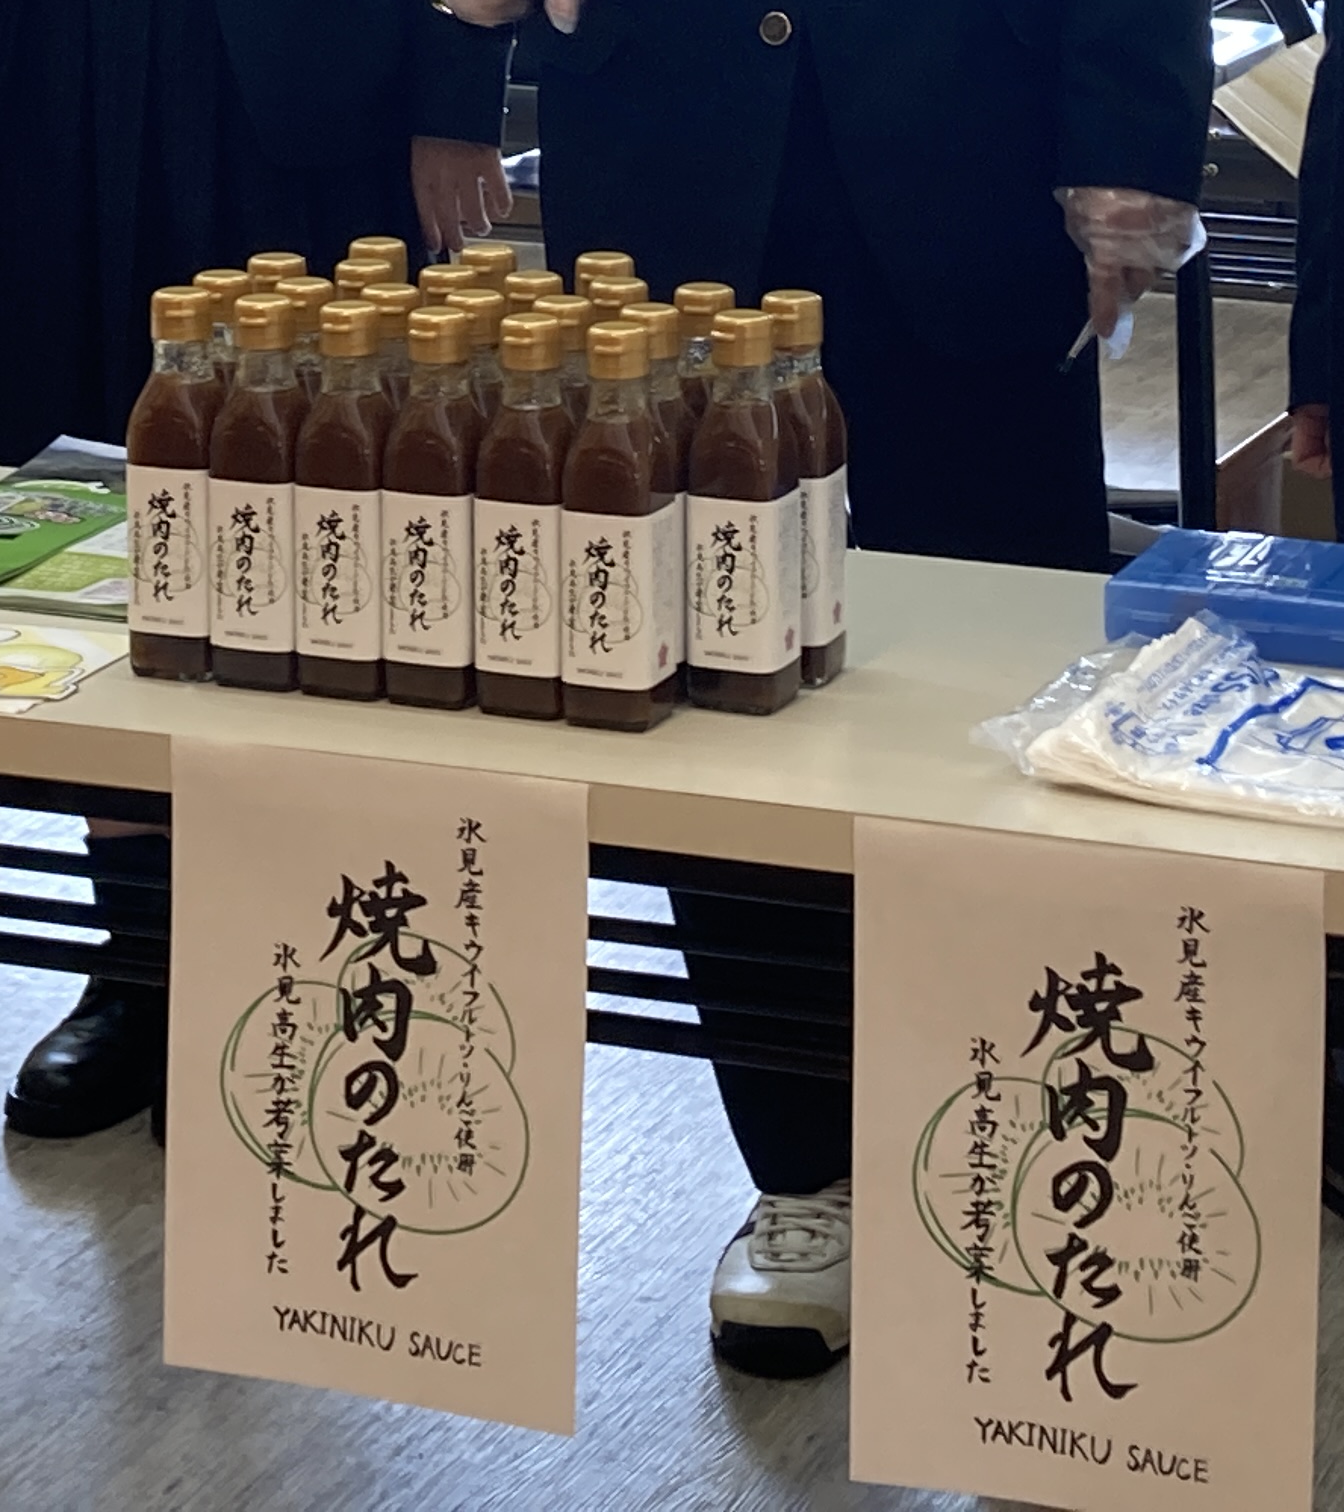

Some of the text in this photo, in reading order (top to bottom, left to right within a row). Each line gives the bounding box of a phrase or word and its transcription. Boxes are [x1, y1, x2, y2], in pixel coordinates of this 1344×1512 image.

[147, 488, 177, 603] 焼肉のたれ
[230, 502, 260, 618] 焼肉のたれ
[315, 509, 346, 626] 焼肉のたれ
[404, 515, 434, 632] 焼肉のたれ
[493, 523, 526, 642] 焼肉のたれ
[584, 536, 616, 654] 焼肉のたれ
[711, 520, 742, 638] 焼肉のたれ
[319, 860, 436, 1292] 焼肉のたれ
[1021, 951, 1154, 1403] 焼肉のたれ
[273, 1305, 483, 1368] YAKINIKU SAUCE
[973, 1415, 1210, 1485] YAKINIKU SAUCE
